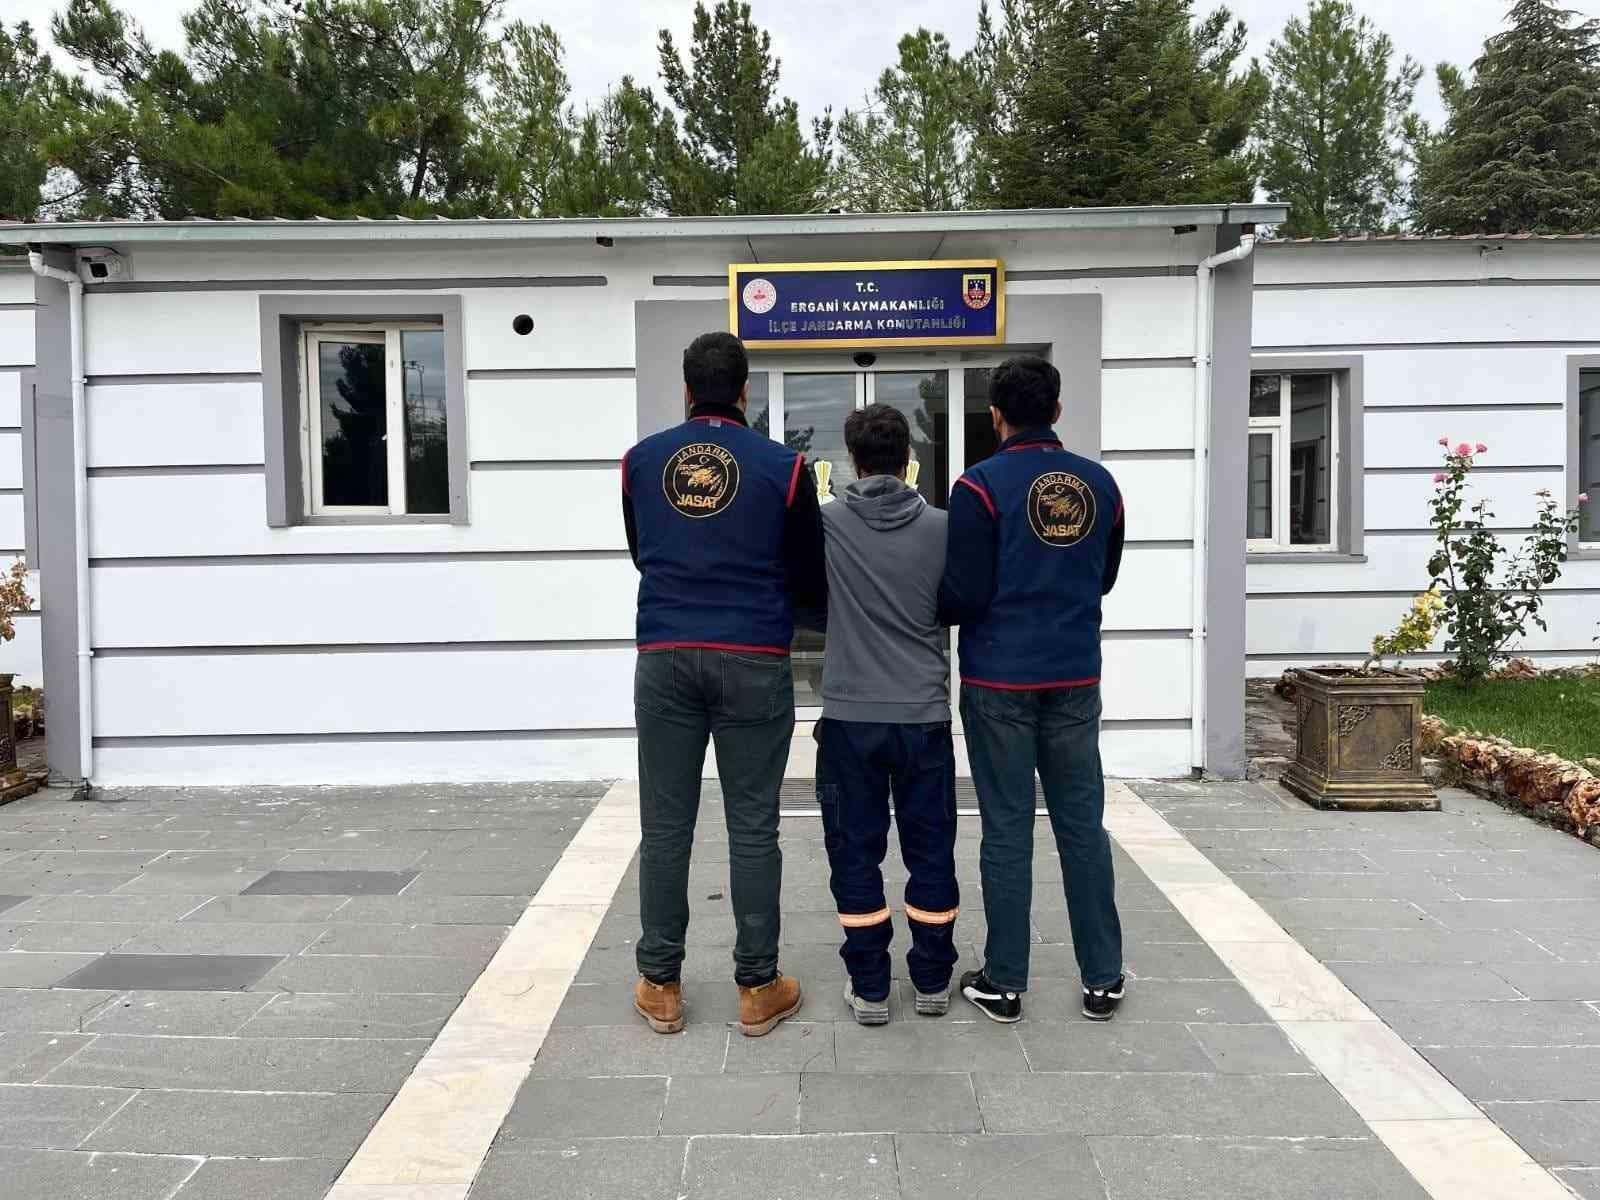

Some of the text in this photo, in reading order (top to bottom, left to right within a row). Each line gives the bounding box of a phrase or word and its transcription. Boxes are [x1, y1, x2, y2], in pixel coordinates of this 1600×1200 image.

[855, 282, 880, 294] T.C.
[791, 297, 945, 313] ERGANİ KAYMAKAMLIĞI
[768, 316, 967, 333] İLÇE JANDARMA KOMUTANLIĞI
[676, 445, 732, 466] JANDARMA
[1034, 474, 1085, 494] JANDARMA
[677, 494, 721, 508] JASAT
[1043, 524, 1081, 536] JASAT
